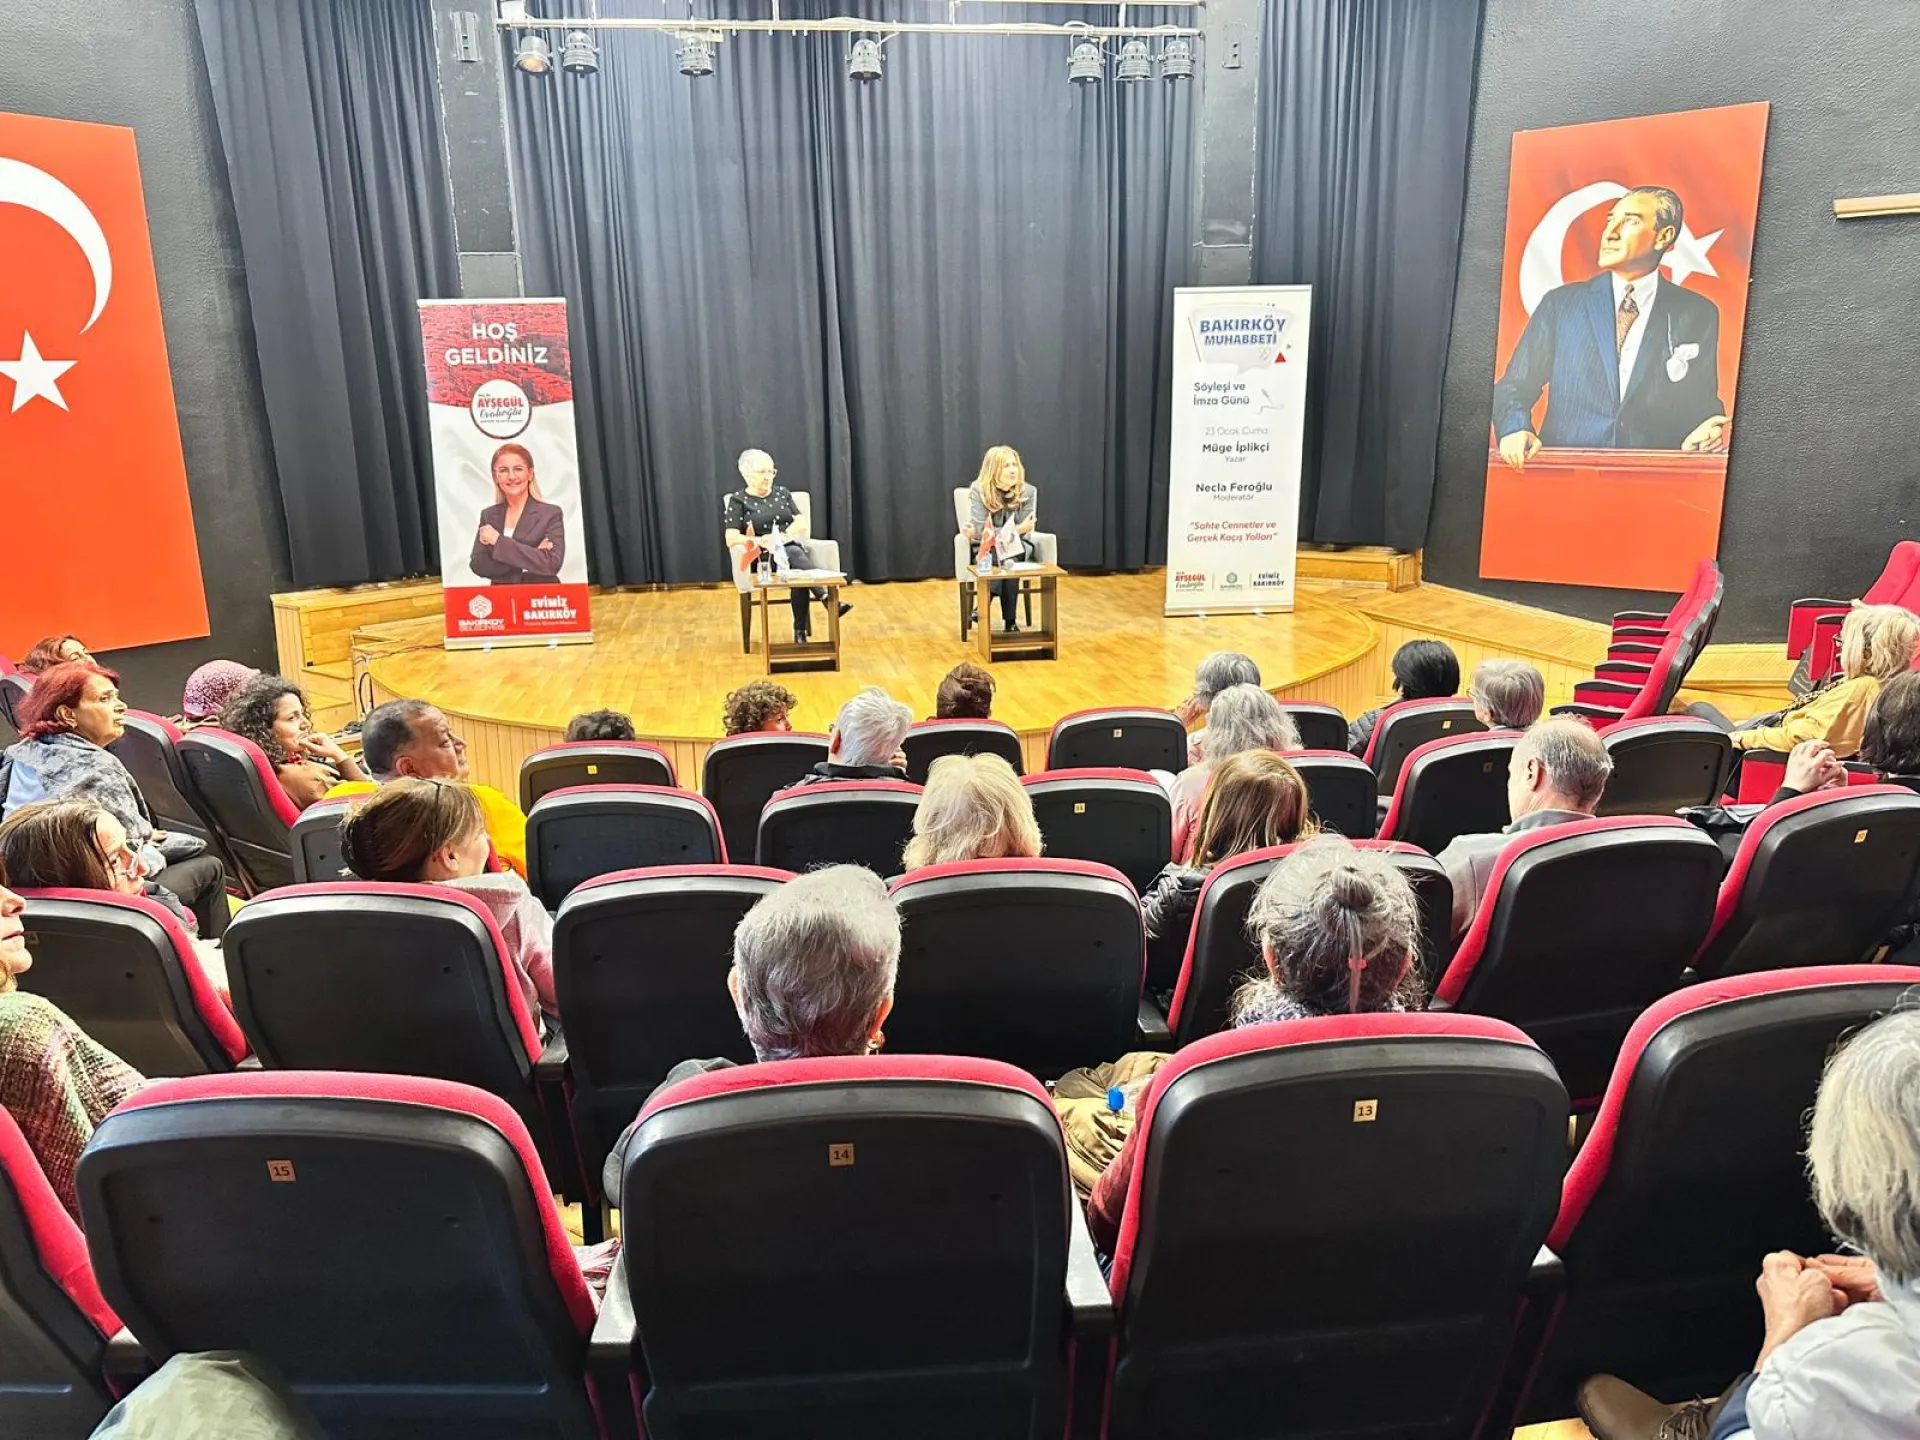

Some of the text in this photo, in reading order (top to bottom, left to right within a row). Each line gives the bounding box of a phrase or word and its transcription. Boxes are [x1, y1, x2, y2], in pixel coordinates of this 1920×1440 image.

[1200, 315, 1286, 333] BAKIRKÖY
[472, 322, 518, 342] HOŞ
[1204, 331, 1277, 346] MUHABBETİ
[444, 343, 548, 366] GELDİNİZ
[1193, 381, 1246, 393] Söyleşi ve
[1193, 394, 1250, 406] İmza Günü
[1202, 440, 1270, 454] Müge İplikçi
[1195, 481, 1273, 493] Necla Feroğlu
[1221, 520, 1264, 529] Cennetler
[1187, 533, 1219, 543] Gerçek
[1220, 532, 1243, 542] Kaçış
[531, 595, 567, 608] EVİMİZ
[523, 607, 577, 620] BAKIRKÖY
[1358, 1106, 1373, 1117] 13
[833, 1149, 849, 1160] 14
[273, 1166, 290, 1177] 15
